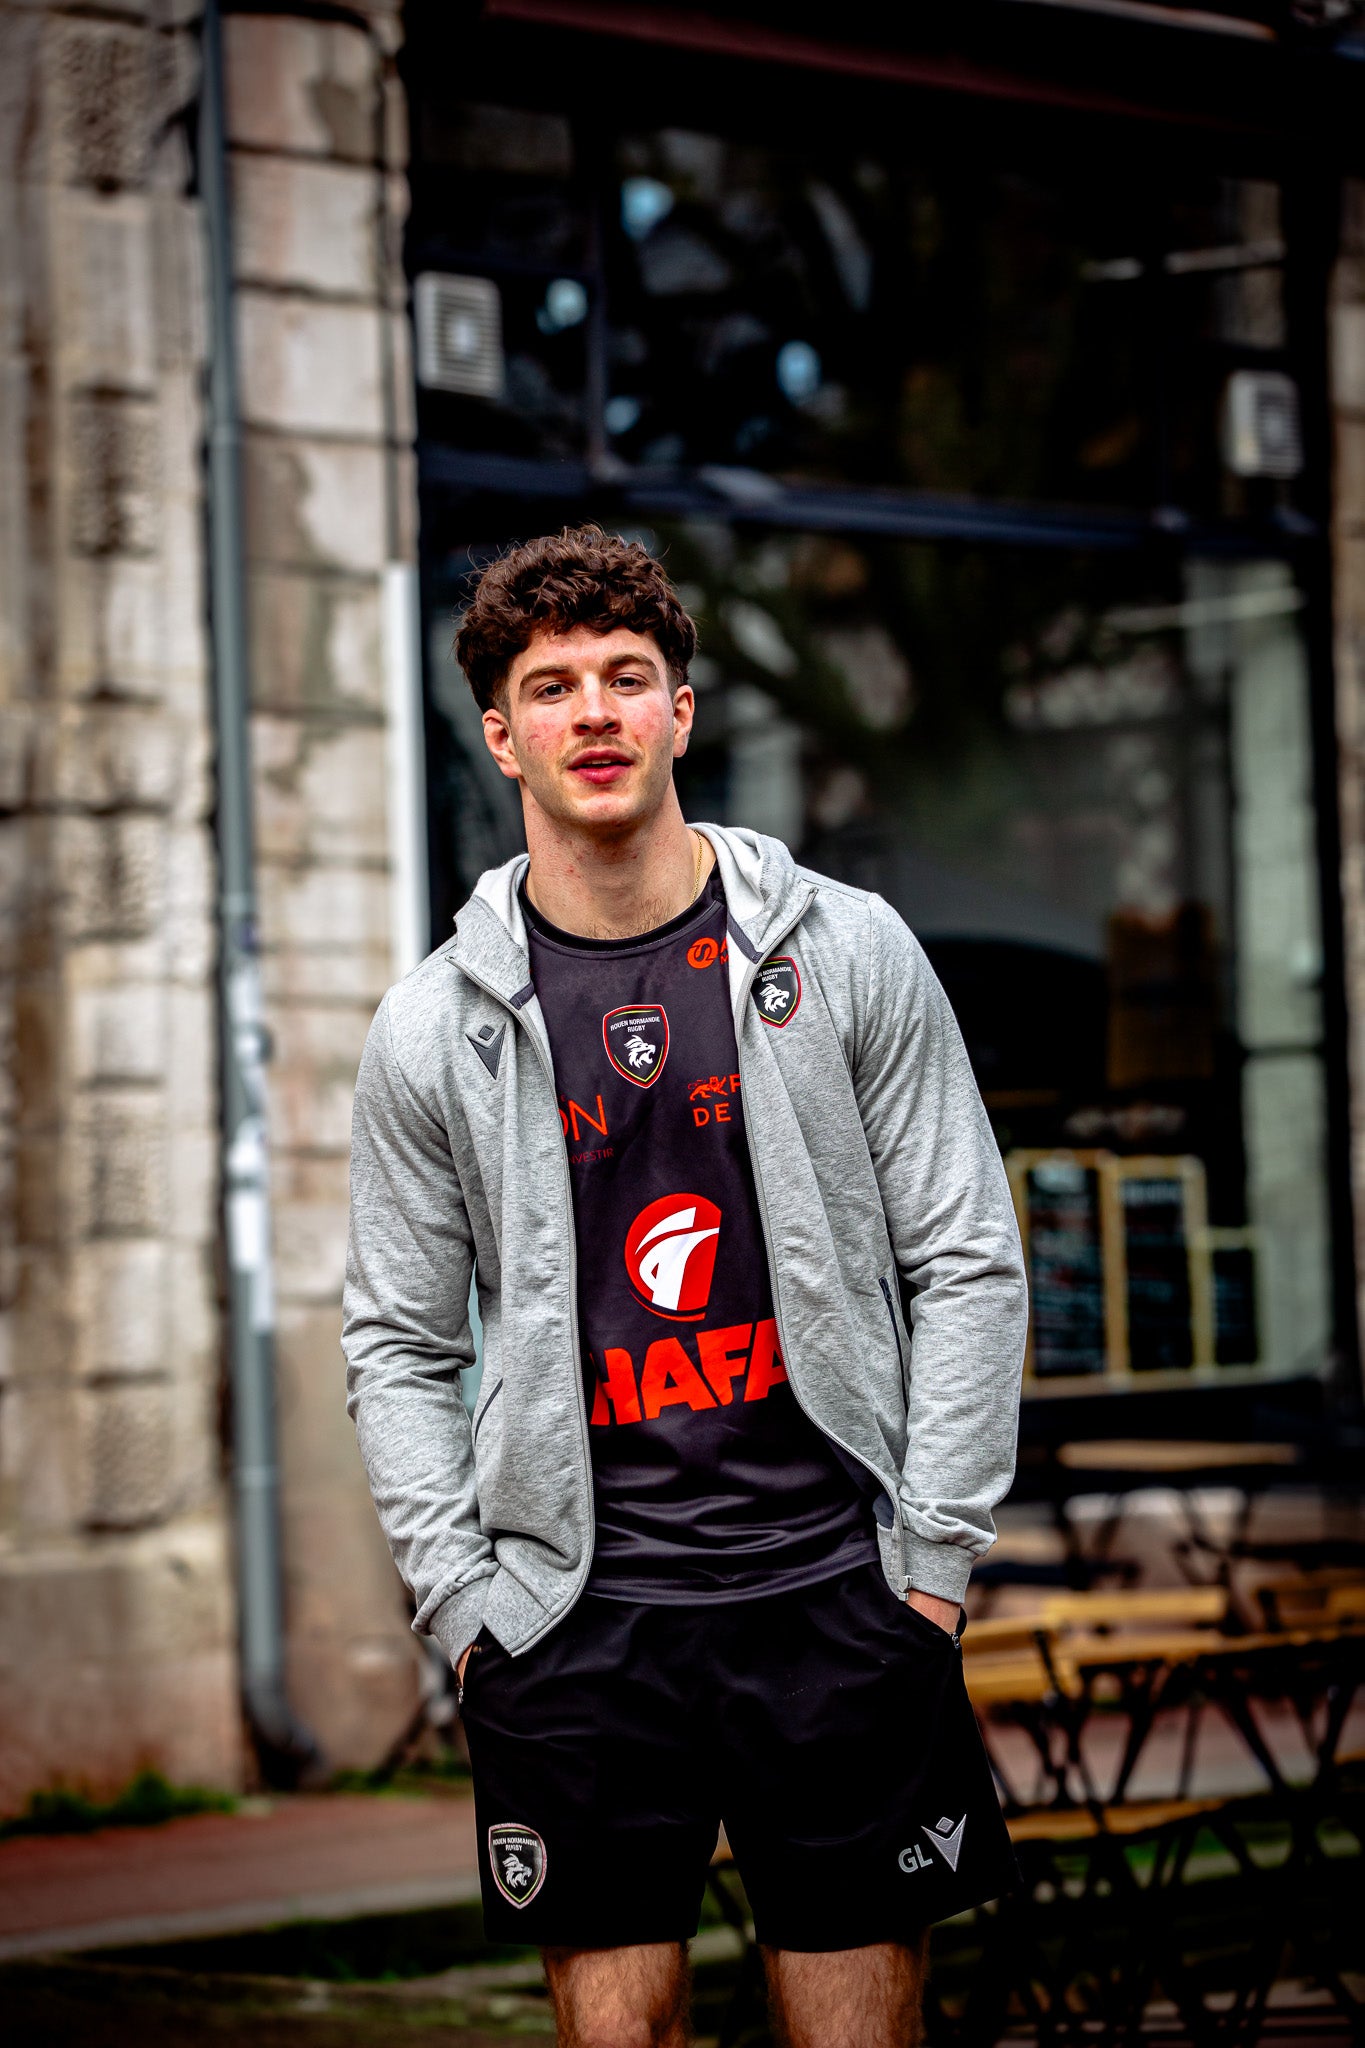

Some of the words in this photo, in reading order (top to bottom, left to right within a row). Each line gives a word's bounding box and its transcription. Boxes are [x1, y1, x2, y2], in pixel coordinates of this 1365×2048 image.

[761, 973, 779, 982] RUGBY
[610, 1019, 629, 1031] ROUEN
[629, 1016, 661, 1026] NORMANDIE
[627, 1024, 646, 1033] RUGBY
[693, 1102, 732, 1127] DE
[898, 1844, 933, 1873] GL
